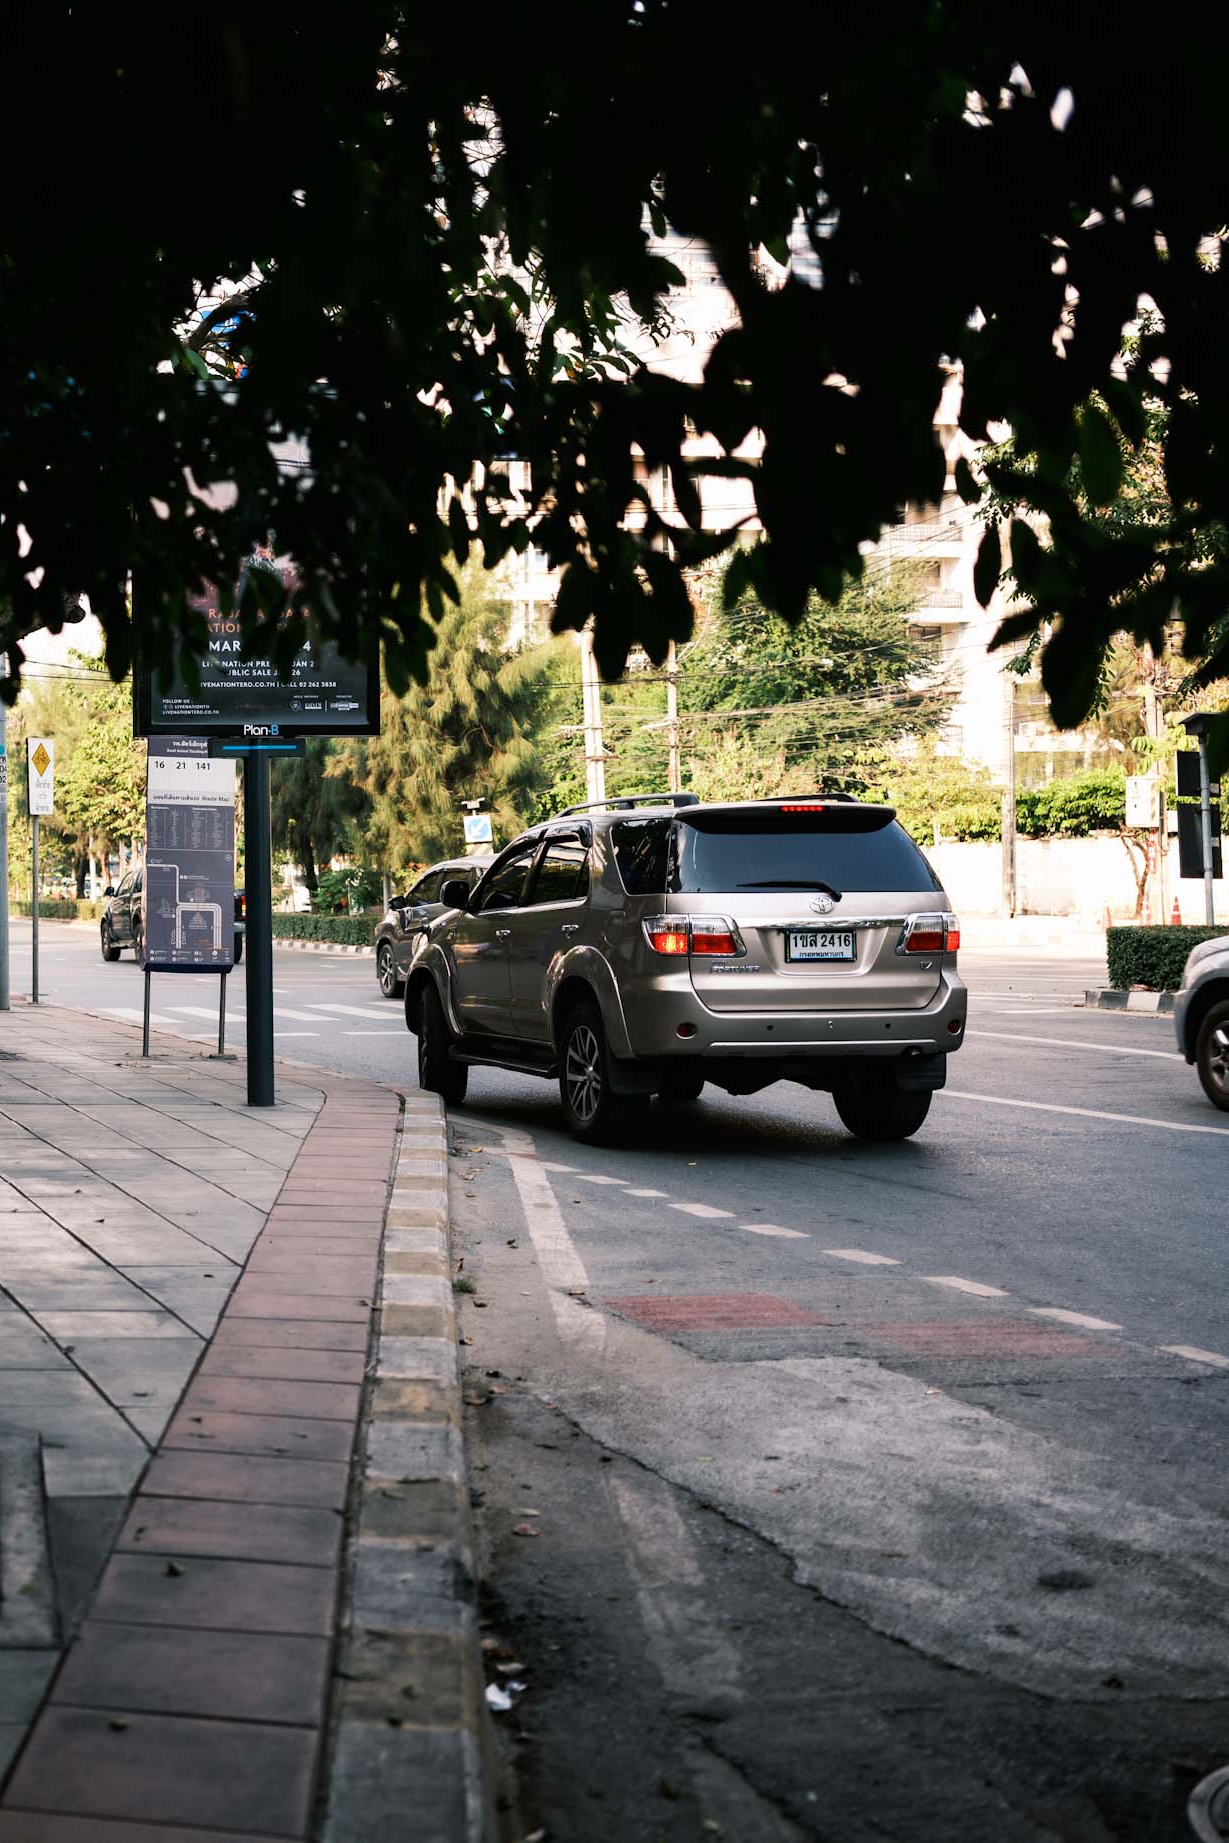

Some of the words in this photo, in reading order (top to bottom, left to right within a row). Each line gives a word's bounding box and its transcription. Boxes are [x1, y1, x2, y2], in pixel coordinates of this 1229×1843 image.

[154, 761, 165, 769] 16
[175, 761, 187, 770] 21
[196, 762, 211, 771] 141
[820, 934, 851, 947] 2416
